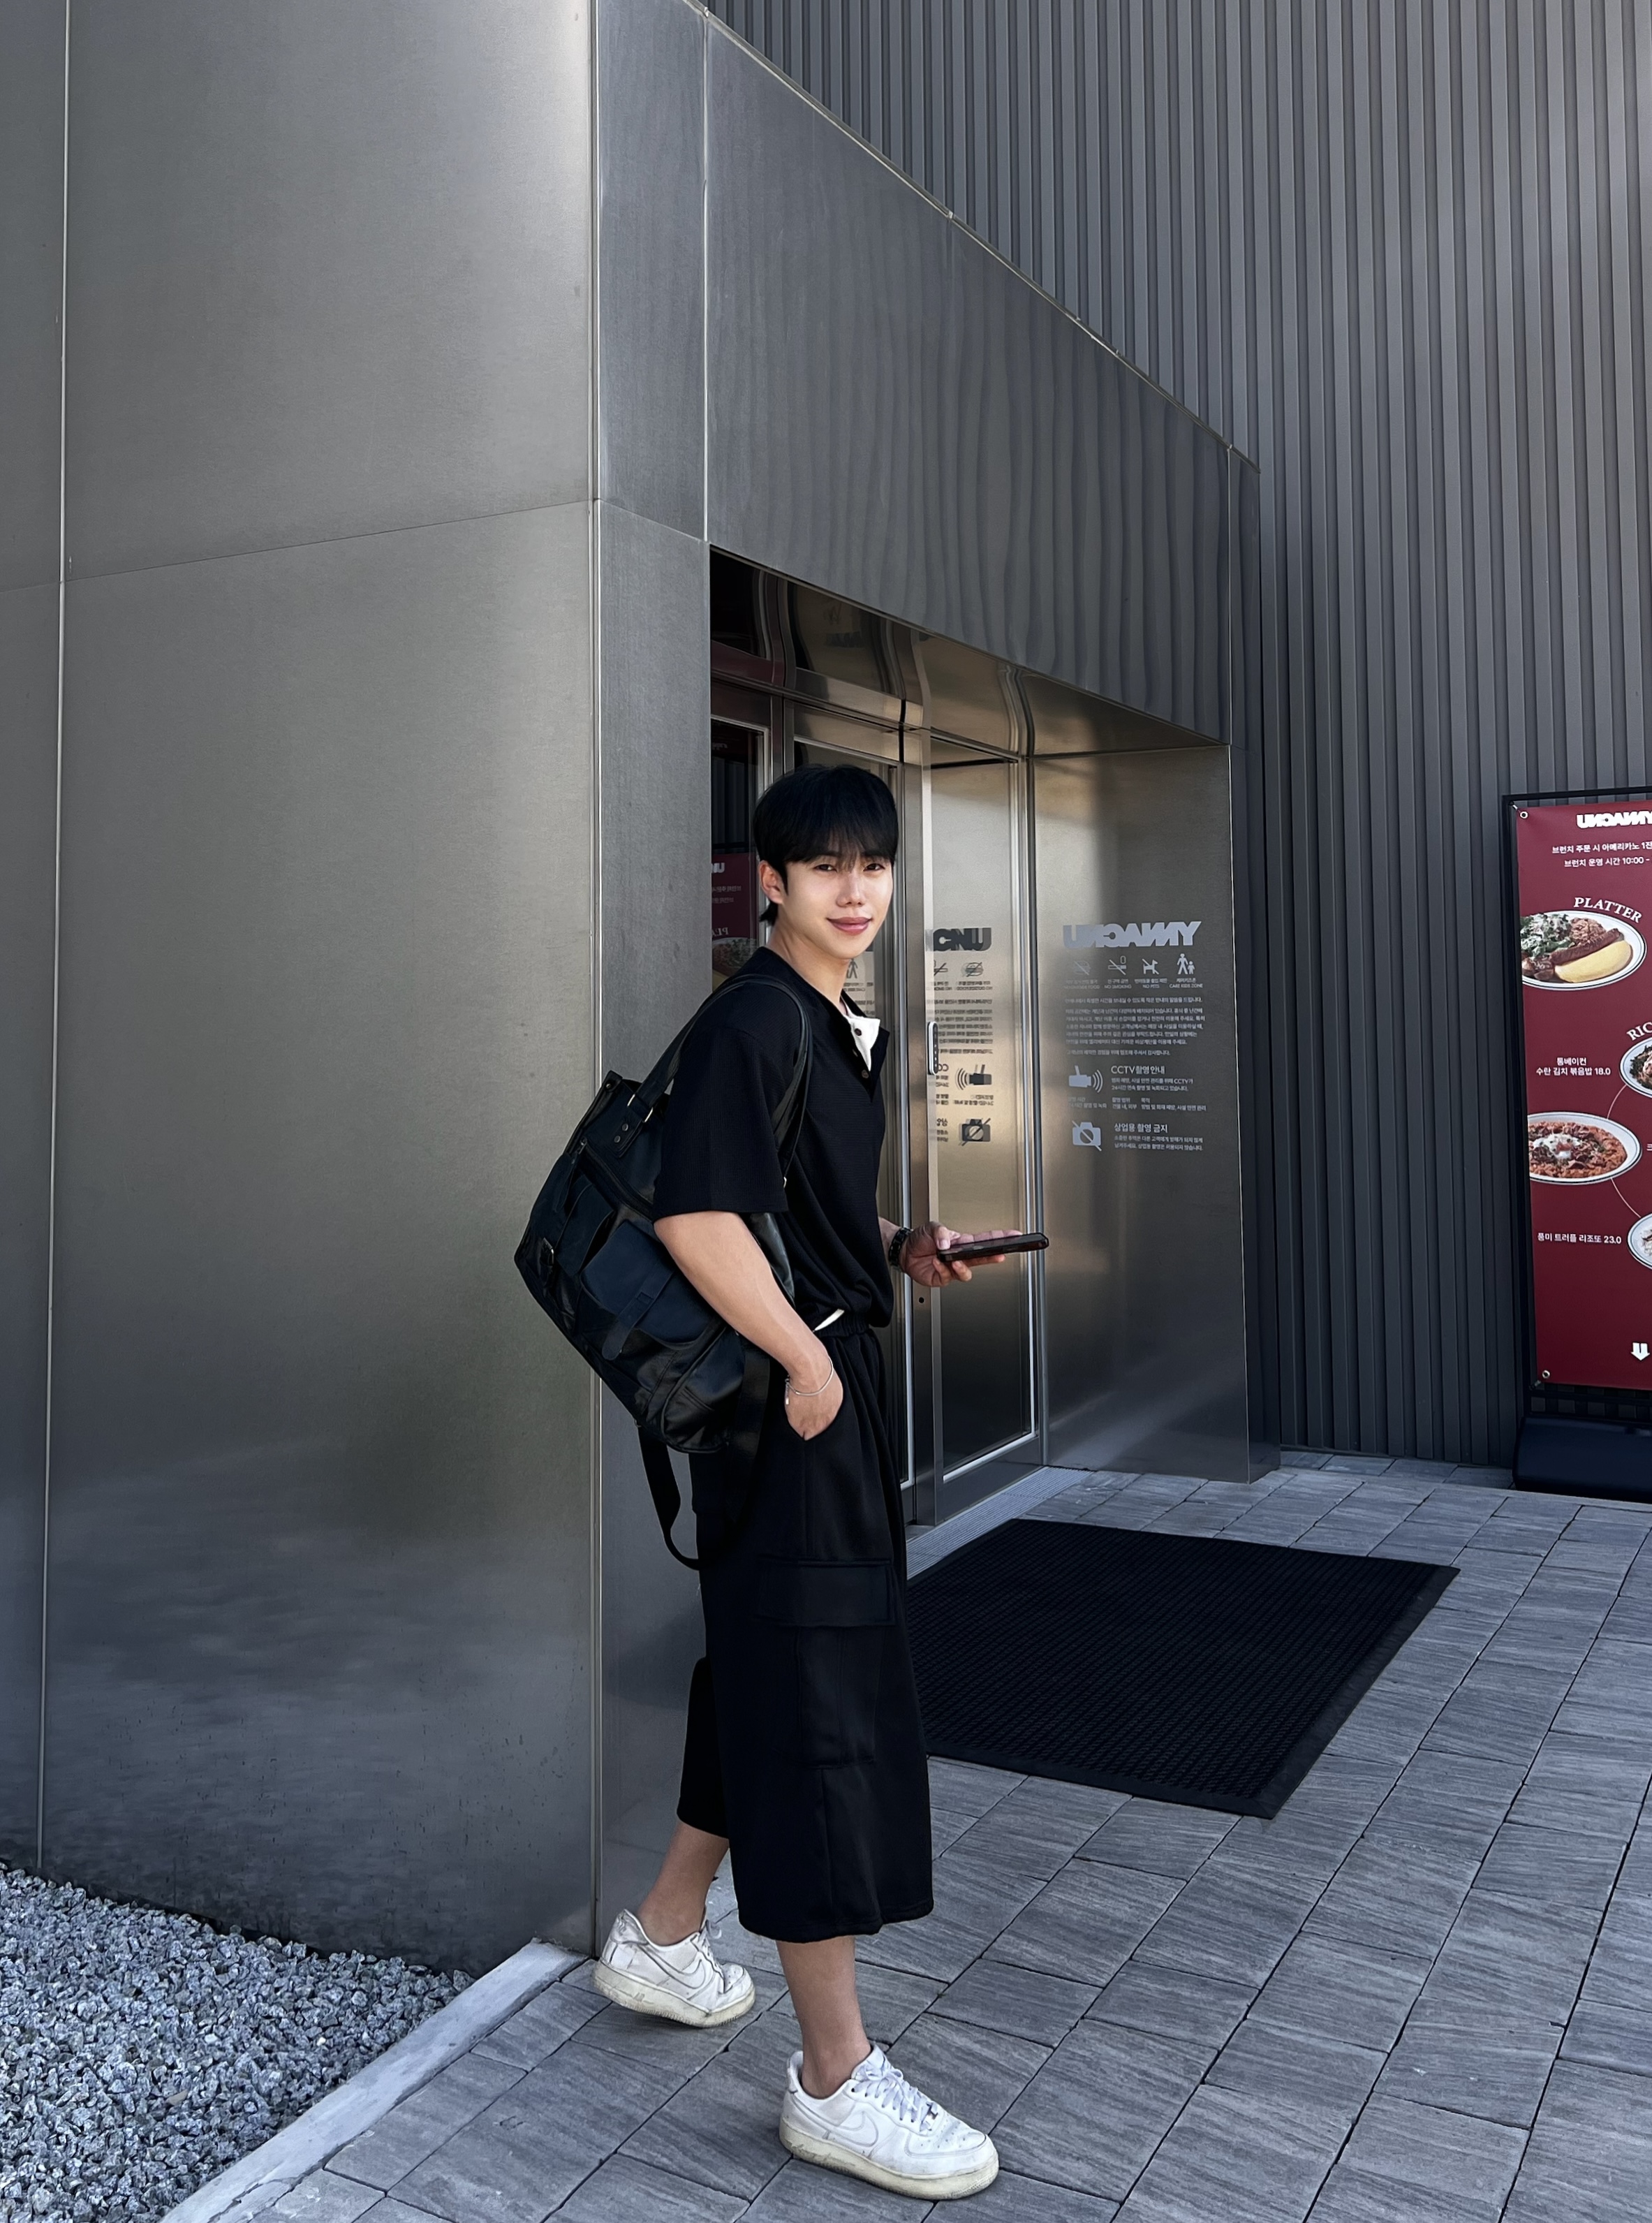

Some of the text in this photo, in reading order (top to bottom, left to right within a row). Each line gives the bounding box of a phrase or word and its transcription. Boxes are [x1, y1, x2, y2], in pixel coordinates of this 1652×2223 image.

[1552, 845, 1574, 854] 브런치
[1576, 844, 1591, 853] 주문
[1593, 844, 1600, 852] 시
[1602, 842, 1639, 851] 아메리카노
[1565, 859, 1586, 867] 브런치
[1588, 858, 1603, 867] 운영
[1605, 857, 1620, 866] 시간
[1623, 856, 1644, 865] 10:00
[1573, 897, 1642, 923] PLATTER
[1557, 1057, 1587, 1066] 통베이컨
[1536, 1067, 1611, 1076] 수란 김치 볶음밥 18.0
[1114, 1123, 1168, 1133] 상업용 촬영 금지
[1537, 1233, 1552, 1241] 풍미
[1554, 1233, 1577, 1242] 트러플
[1604, 1235, 1621, 1244] 23.0
